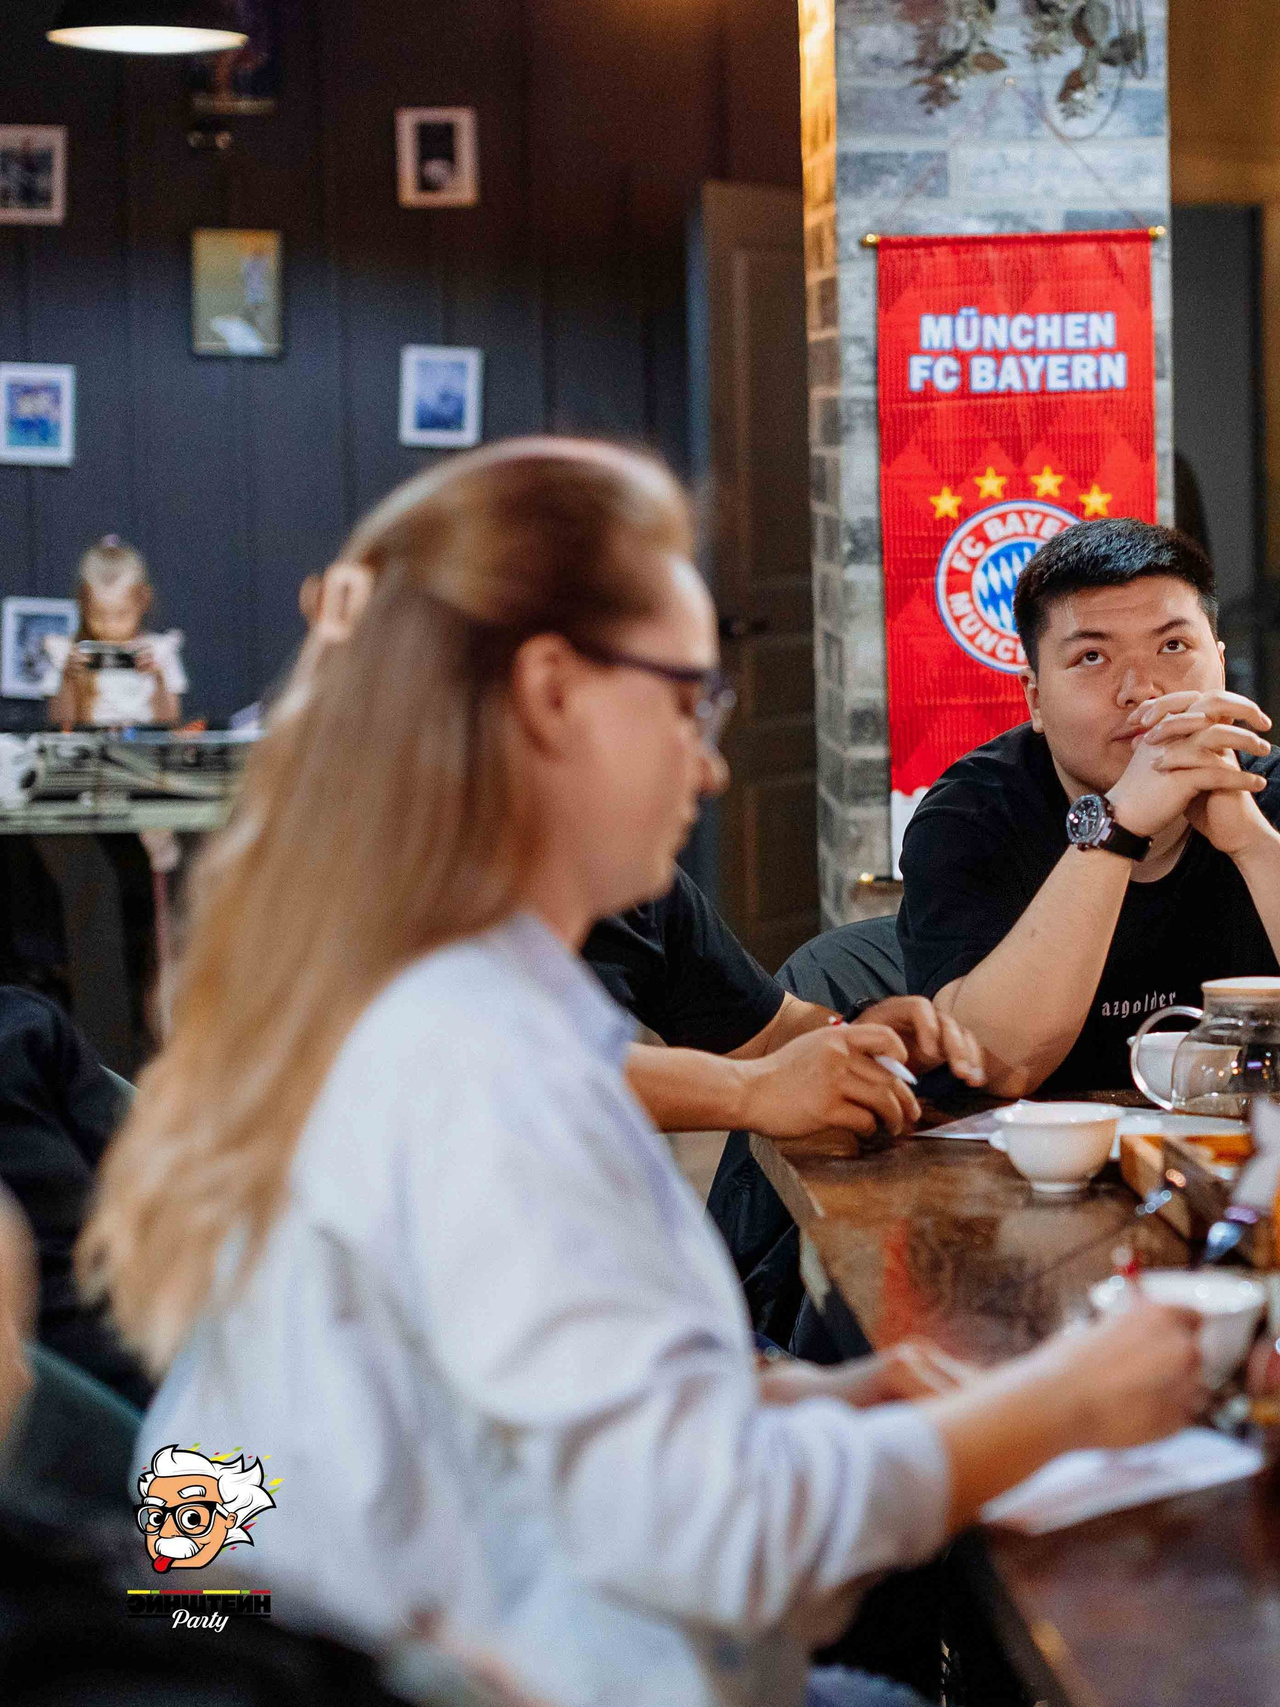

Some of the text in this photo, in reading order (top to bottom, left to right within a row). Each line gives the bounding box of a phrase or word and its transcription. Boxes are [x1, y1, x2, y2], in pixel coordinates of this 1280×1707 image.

[919, 306, 1116, 350] MÜNCHEN
[908, 352, 1127, 393] FC BAYERN
[951, 511, 1070, 574] FC BAYE
[1101, 990, 1177, 1019] azgolder
